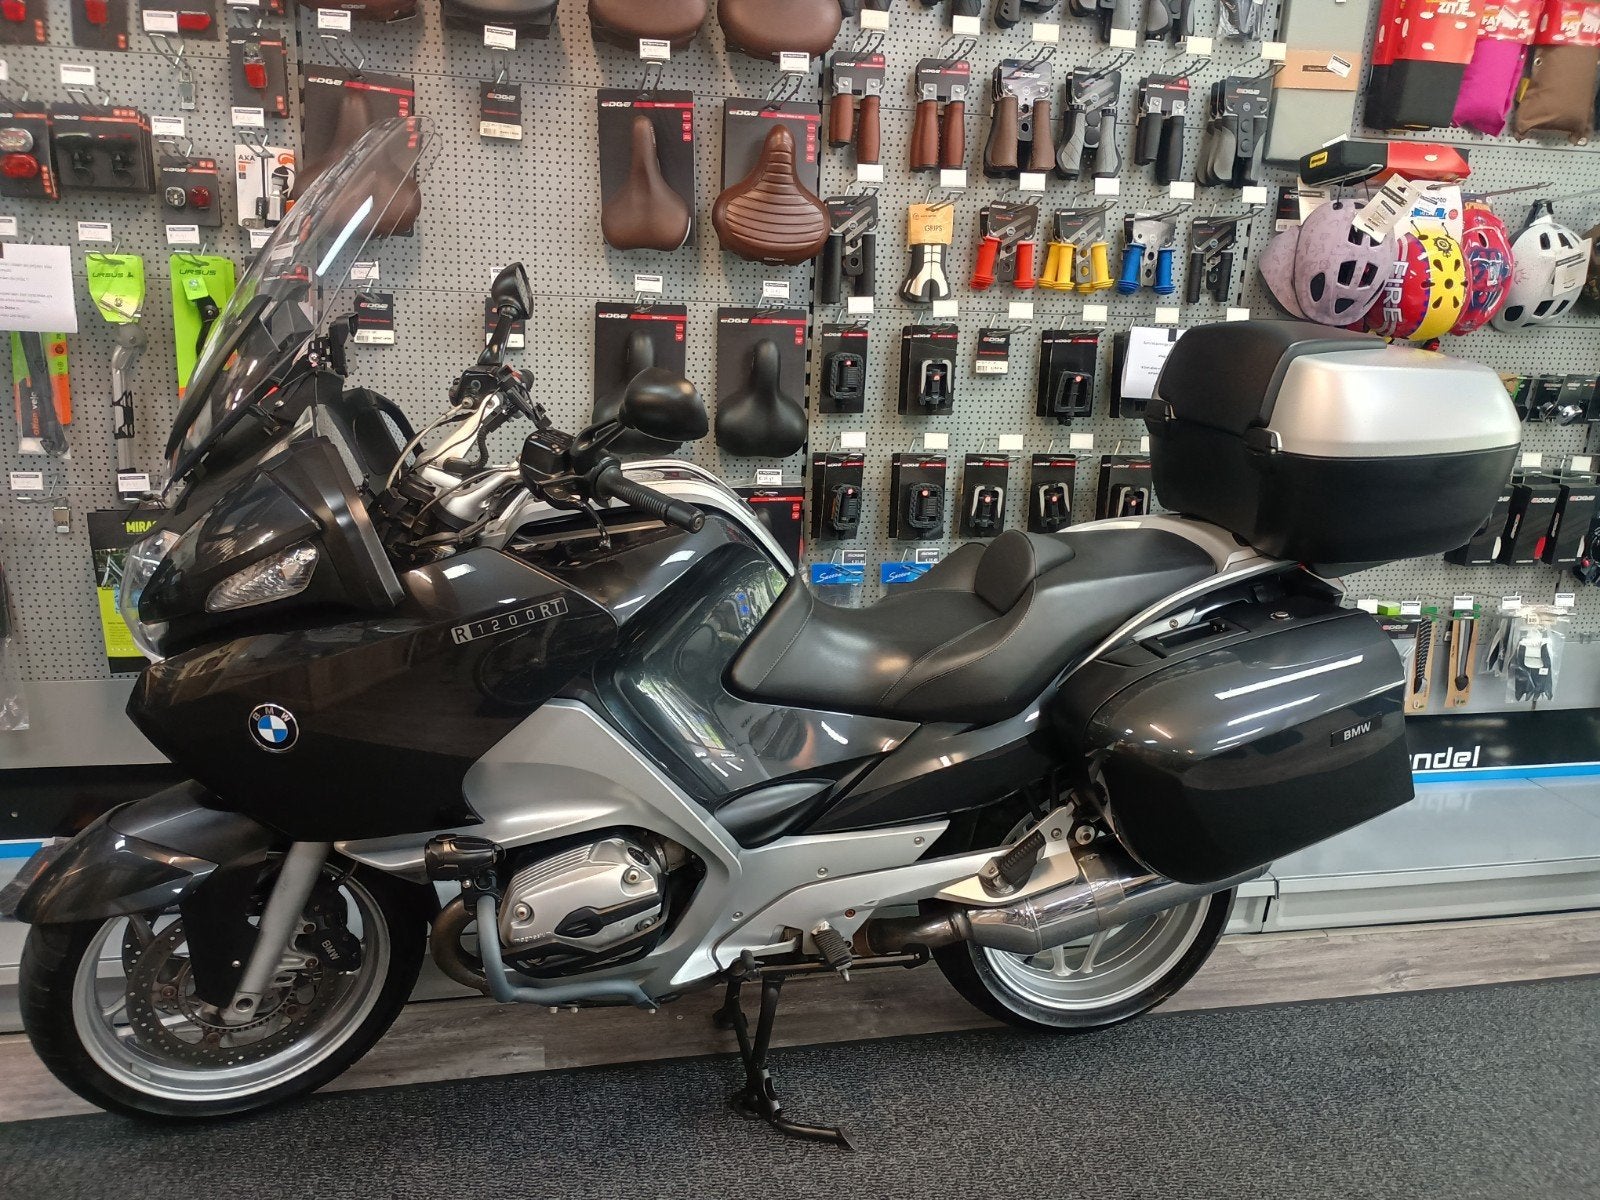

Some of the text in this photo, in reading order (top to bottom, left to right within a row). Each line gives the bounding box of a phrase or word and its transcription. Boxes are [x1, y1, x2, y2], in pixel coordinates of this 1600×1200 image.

[1383, 261, 1409, 322] FIRE
[252, 706, 291, 722] BMW
[1343, 721, 1372, 741] BMW
[321, 939, 341, 962] BMW
